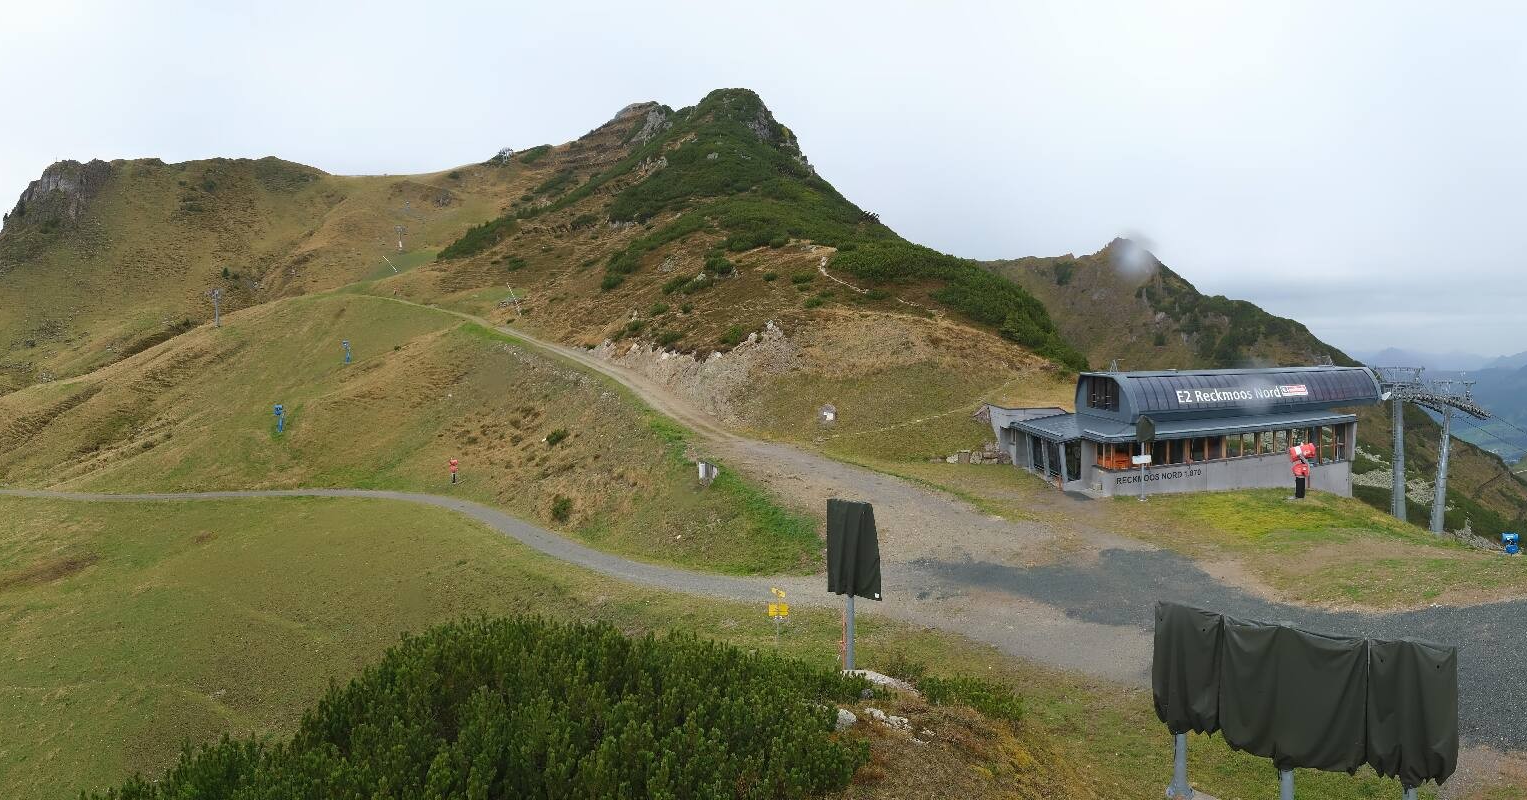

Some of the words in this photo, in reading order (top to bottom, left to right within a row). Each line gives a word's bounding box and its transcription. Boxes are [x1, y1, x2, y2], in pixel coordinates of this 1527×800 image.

[1176, 390, 1193, 403] E2
[1194, 388, 1253, 402] Reckmoos
[1255, 385, 1282, 400] Nord
[1161, 471, 1183, 480] NORD
